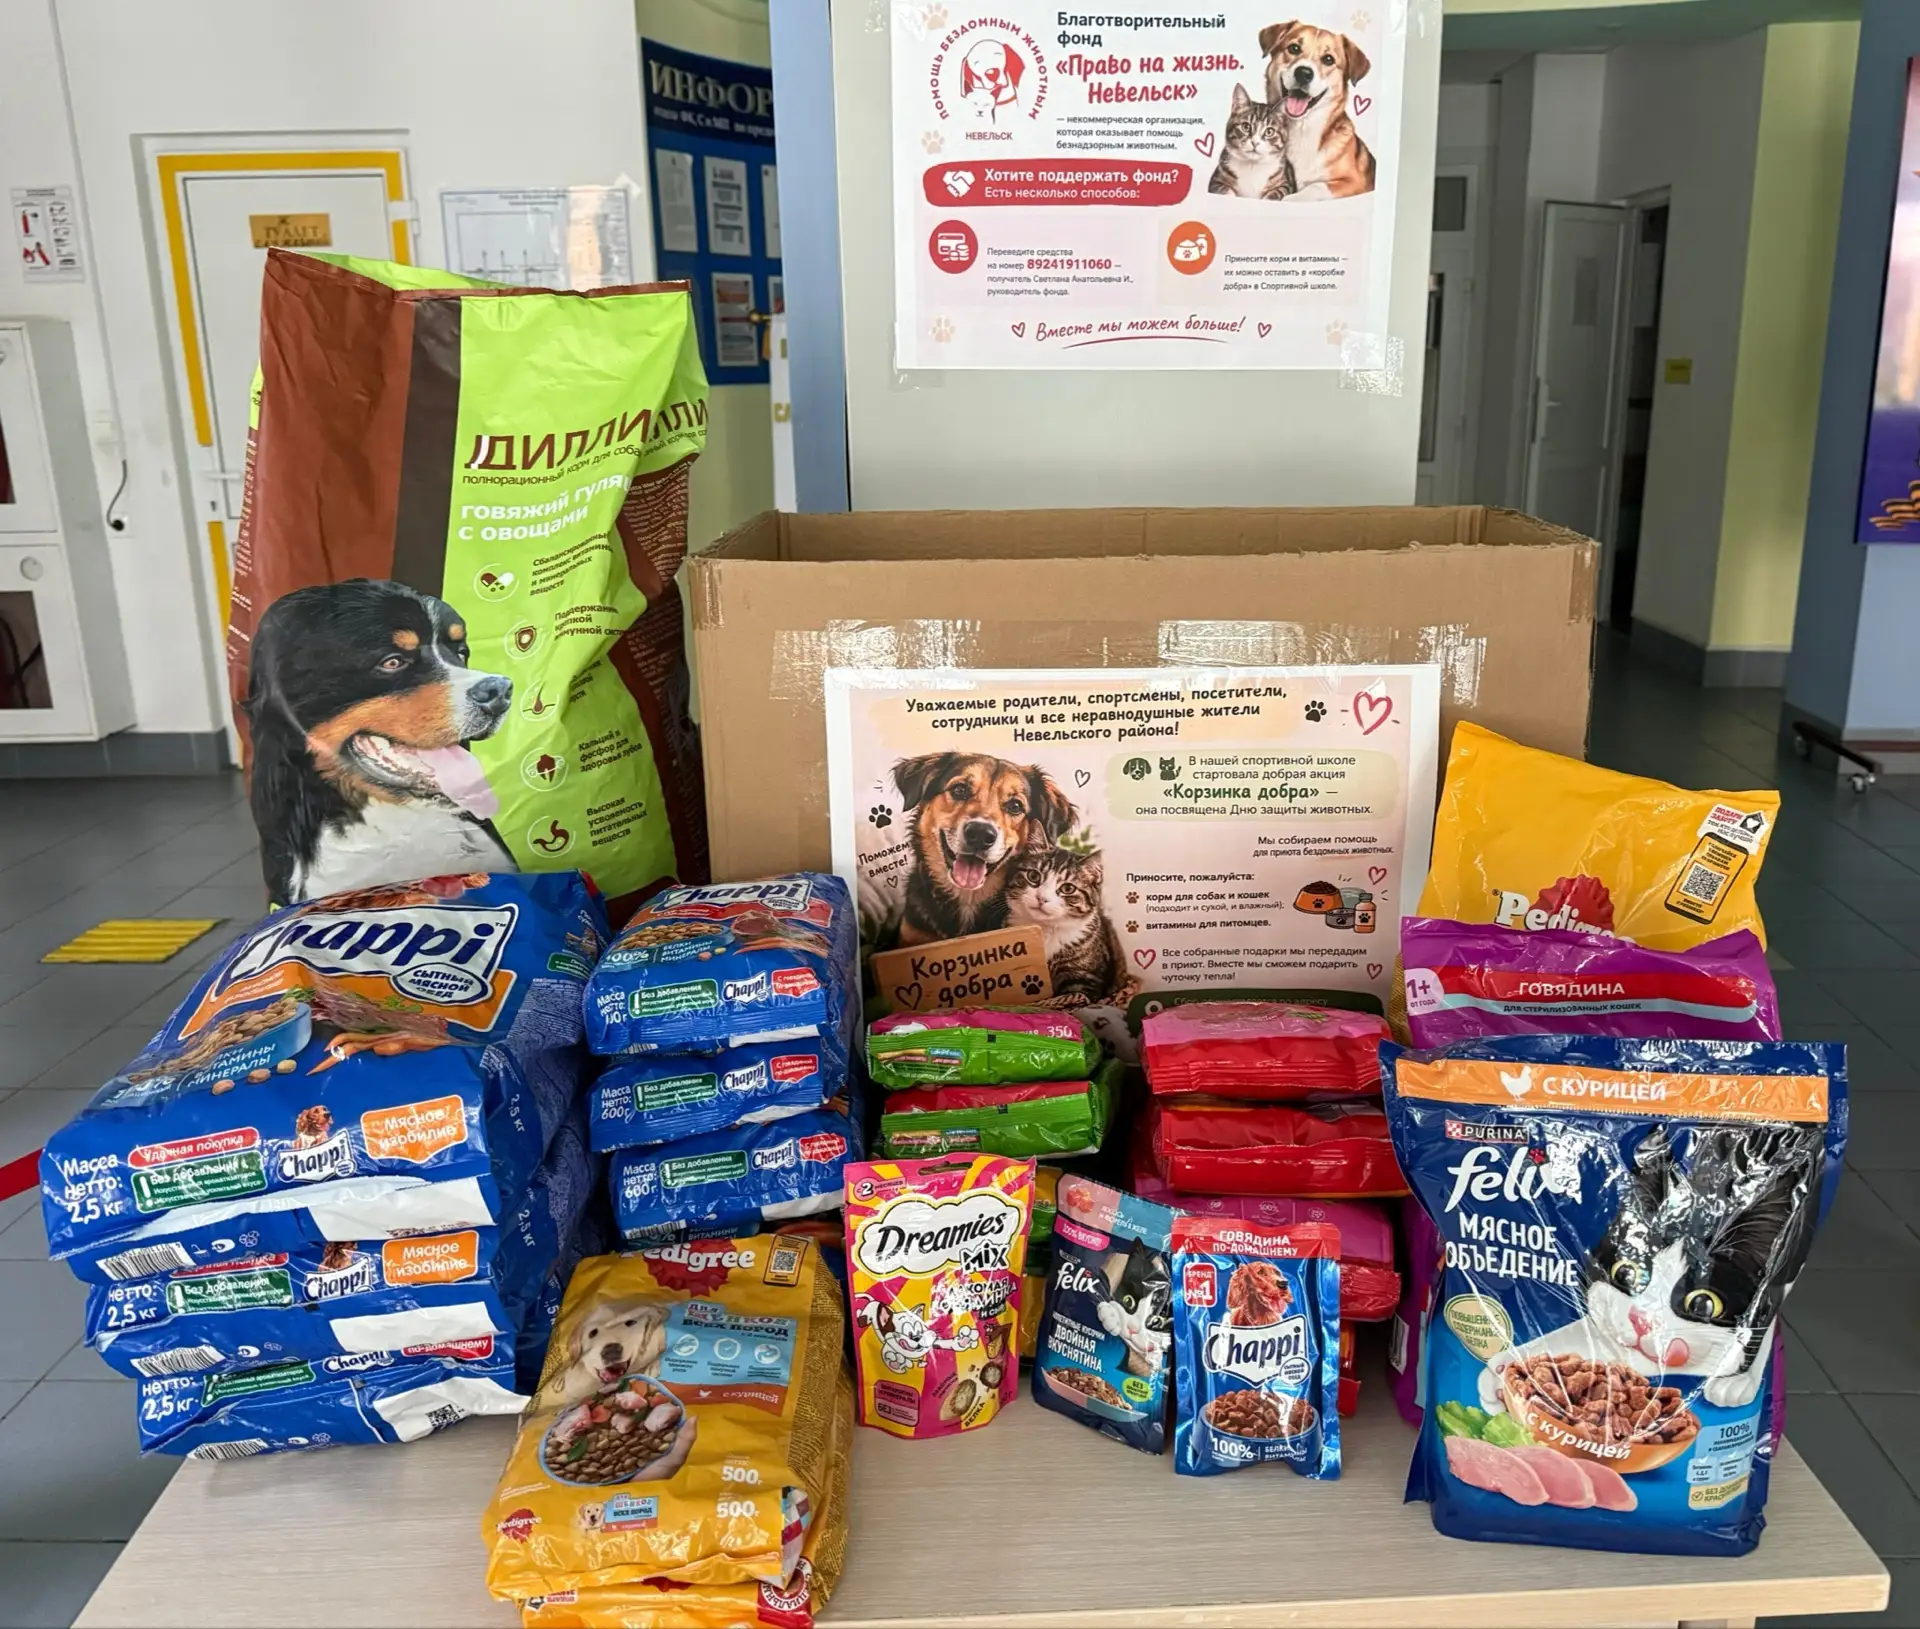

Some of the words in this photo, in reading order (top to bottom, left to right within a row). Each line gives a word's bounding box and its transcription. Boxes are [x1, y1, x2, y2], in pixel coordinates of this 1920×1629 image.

[1057, 12, 1226, 30] Благотворительный
[1057, 31, 1103, 48] фонд
[930, 53, 950, 121] ПОМОЩЬ
[1022, 33, 1049, 120] ЖИВОТНЫМ
[1056, 54, 1131, 82] «Право
[1140, 56, 1164, 73] на
[1172, 54, 1245, 72] жизнь.
[1088, 82, 1198, 104] Невельск»
[1066, 116, 1143, 125] некоммерческая
[1145, 116, 1206, 126] организация,
[965, 131, 1013, 141] НЕВЕЛЬСК
[1056, 129, 1093, 138] которая
[1095, 129, 1145, 138] оказывает
[1146, 129, 1184, 139] помощь
[1056, 140, 1124, 150] безнадзорным
[1126, 141, 1178, 150] животным.
[984, 168, 1034, 182] Хотите
[1038, 169, 1128, 185] поддержать
[1132, 169, 1180, 185] фонд?
[984, 187, 1012, 198] Есть
[1015, 188, 1078, 199] несколько
[1080, 187, 1140, 199] способов:
[987, 248, 1035, 258] Переведите
[1036, 249, 1074, 259] средства
[1224, 254, 1268, 264] Принесите
[1299, 256, 1340, 264] витамины
[1027, 258, 1112, 270] 89241911060
[1033, 274, 1070, 284] Светлана
[1223, 282, 1252, 292] добра»
[1260, 281, 1308, 292] Спортивной
[987, 287, 1041, 297] руководитель
[1036, 322, 1093, 342] Вместе
[1098, 322, 1122, 333] мы
[1126, 318, 1180, 332] можем
[1185, 314, 1247, 334] больше!
[462, 466, 565, 487] полнорационный
[566, 458, 590, 477] корм
[592, 450, 611, 466] для
[460, 493, 570, 521] говяжий
[458, 527, 474, 541] с
[480, 505, 589, 541] овощами
[906, 696, 997, 713] Уважаемые
[1003, 693, 1081, 711] родители,
[1087, 689, 1185, 709] спортсмены,
[1191, 685, 1287, 702] посетители,
[931, 713, 1019, 732] сотрудники
[1040, 713, 1066, 724] все
[1072, 707, 1195, 724] неравнодушные
[1201, 704, 1260, 718] жители
[1013, 728, 1112, 742] Невельского
[1118, 723, 1179, 742] района!
[1200, 755, 1239, 766] нашей
[1242, 755, 1314, 769] спортивной
[1316, 755, 1356, 766] школе
[1192, 770, 1260, 782] стартовала
[1262, 769, 1307, 782] добрая
[1308, 769, 1346, 781] акция
[1163, 783, 1251, 803] «Корзинка
[1258, 785, 1319, 803] добра»
[1135, 806, 1158, 816] она
[1160, 805, 1228, 817] посвящена
[1229, 805, 1258, 817] Дню
[1260, 805, 1307, 817] защиты
[1310, 804, 1373, 815] животных.
[1258, 836, 1275, 845] Мы
[1278, 835, 1332, 847] собираем
[1334, 834, 1378, 845] помощь
[858, 840, 911, 866] Поможем
[1270, 848, 1301, 858] приюта
[1303, 847, 1350, 857] бездомных
[868, 855, 908, 878] вместе!
[1126, 872, 1187, 884] Приносите,
[1189, 872, 1255, 884] пожалуйста:
[1146, 894, 1173, 903] корм
[1175, 893, 1194, 902] для
[1196, 891, 1226, 901] собак
[1237, 891, 1270, 899] кошек
[1146, 904, 1191, 913] (подходит
[1494, 890, 1636, 943] Pedi
[1146, 921, 1197, 930] витамины
[1199, 920, 1218, 930] для
[1219, 919, 1272, 929] питомцев.
[910, 939, 1028, 981] Корзинка
[1162, 948, 1181, 957] Все
[1183, 947, 1240, 958] собранные
[1243, 948, 1287, 958] подарки
[1308, 948, 1367, 957] передадим
[1170, 962, 1205, 971] приют.
[1207, 960, 1245, 969] Вместе
[1265, 960, 1306, 968] сможем
[1309, 960, 1358, 970] подарить
[1161, 973, 1201, 984] чуточку
[1203, 972, 1236, 982] тепла!
[722, 980, 766, 1001] Chappi
[937, 971, 1013, 1009] добра
[1518, 979, 1626, 998] ГОВЯДИНА
[1522, 1003, 1608, 1014] СТЕРИЛИЗОВАННЫХ
[1609, 1001, 1642, 1011] КОШЕК
[722, 1062, 765, 1090] Chappi
[601, 1085, 631, 1100] Масса
[1543, 1076, 1557, 1094] С
[1561, 1077, 1668, 1102] КУРИЦЕЙ
[601, 1095, 632, 1109] нетто:
[384, 1108, 445, 1131] Мясное
[1464, 1125, 1525, 1141] PURINA
[60, 1153, 119, 1176] Масса
[279, 1138, 350, 1183] Chappi
[752, 1142, 793, 1168] Chappi
[623, 1162, 656, 1176] Масса
[64, 1175, 123, 1199] нетто:
[66, 1198, 100, 1225] 2,5
[876, 1212, 1006, 1259] Dreamies
[1219, 1230, 1291, 1246] ГОВЯДИНА
[1459, 1212, 1558, 1254] МЯСНОЕ
[403, 1241, 460, 1261] Мясное
[1212, 1242, 1298, 1257] ПО-ДОМАШНЕМУ
[1445, 1239, 1580, 1288] ОБЪЕДЕНИЕ
[305, 1268, 369, 1301] Chappi
[1054, 1261, 1101, 1294] felix
[107, 1283, 158, 1302] нетто:
[106, 1303, 138, 1328] 2,5
[1054, 1323, 1097, 1352] ДВОЙНАЯ
[1047, 1335, 1104, 1373] ВКУСНЯТИНА
[1204, 1326, 1303, 1371] Chappi
[142, 1376, 196, 1396] нетто:
[143, 1397, 174, 1422] 2,5
[1719, 1422, 1750, 1439] 100%
[1211, 1437, 1255, 1459] 100%
[1538, 1421, 1632, 1461] курицей
